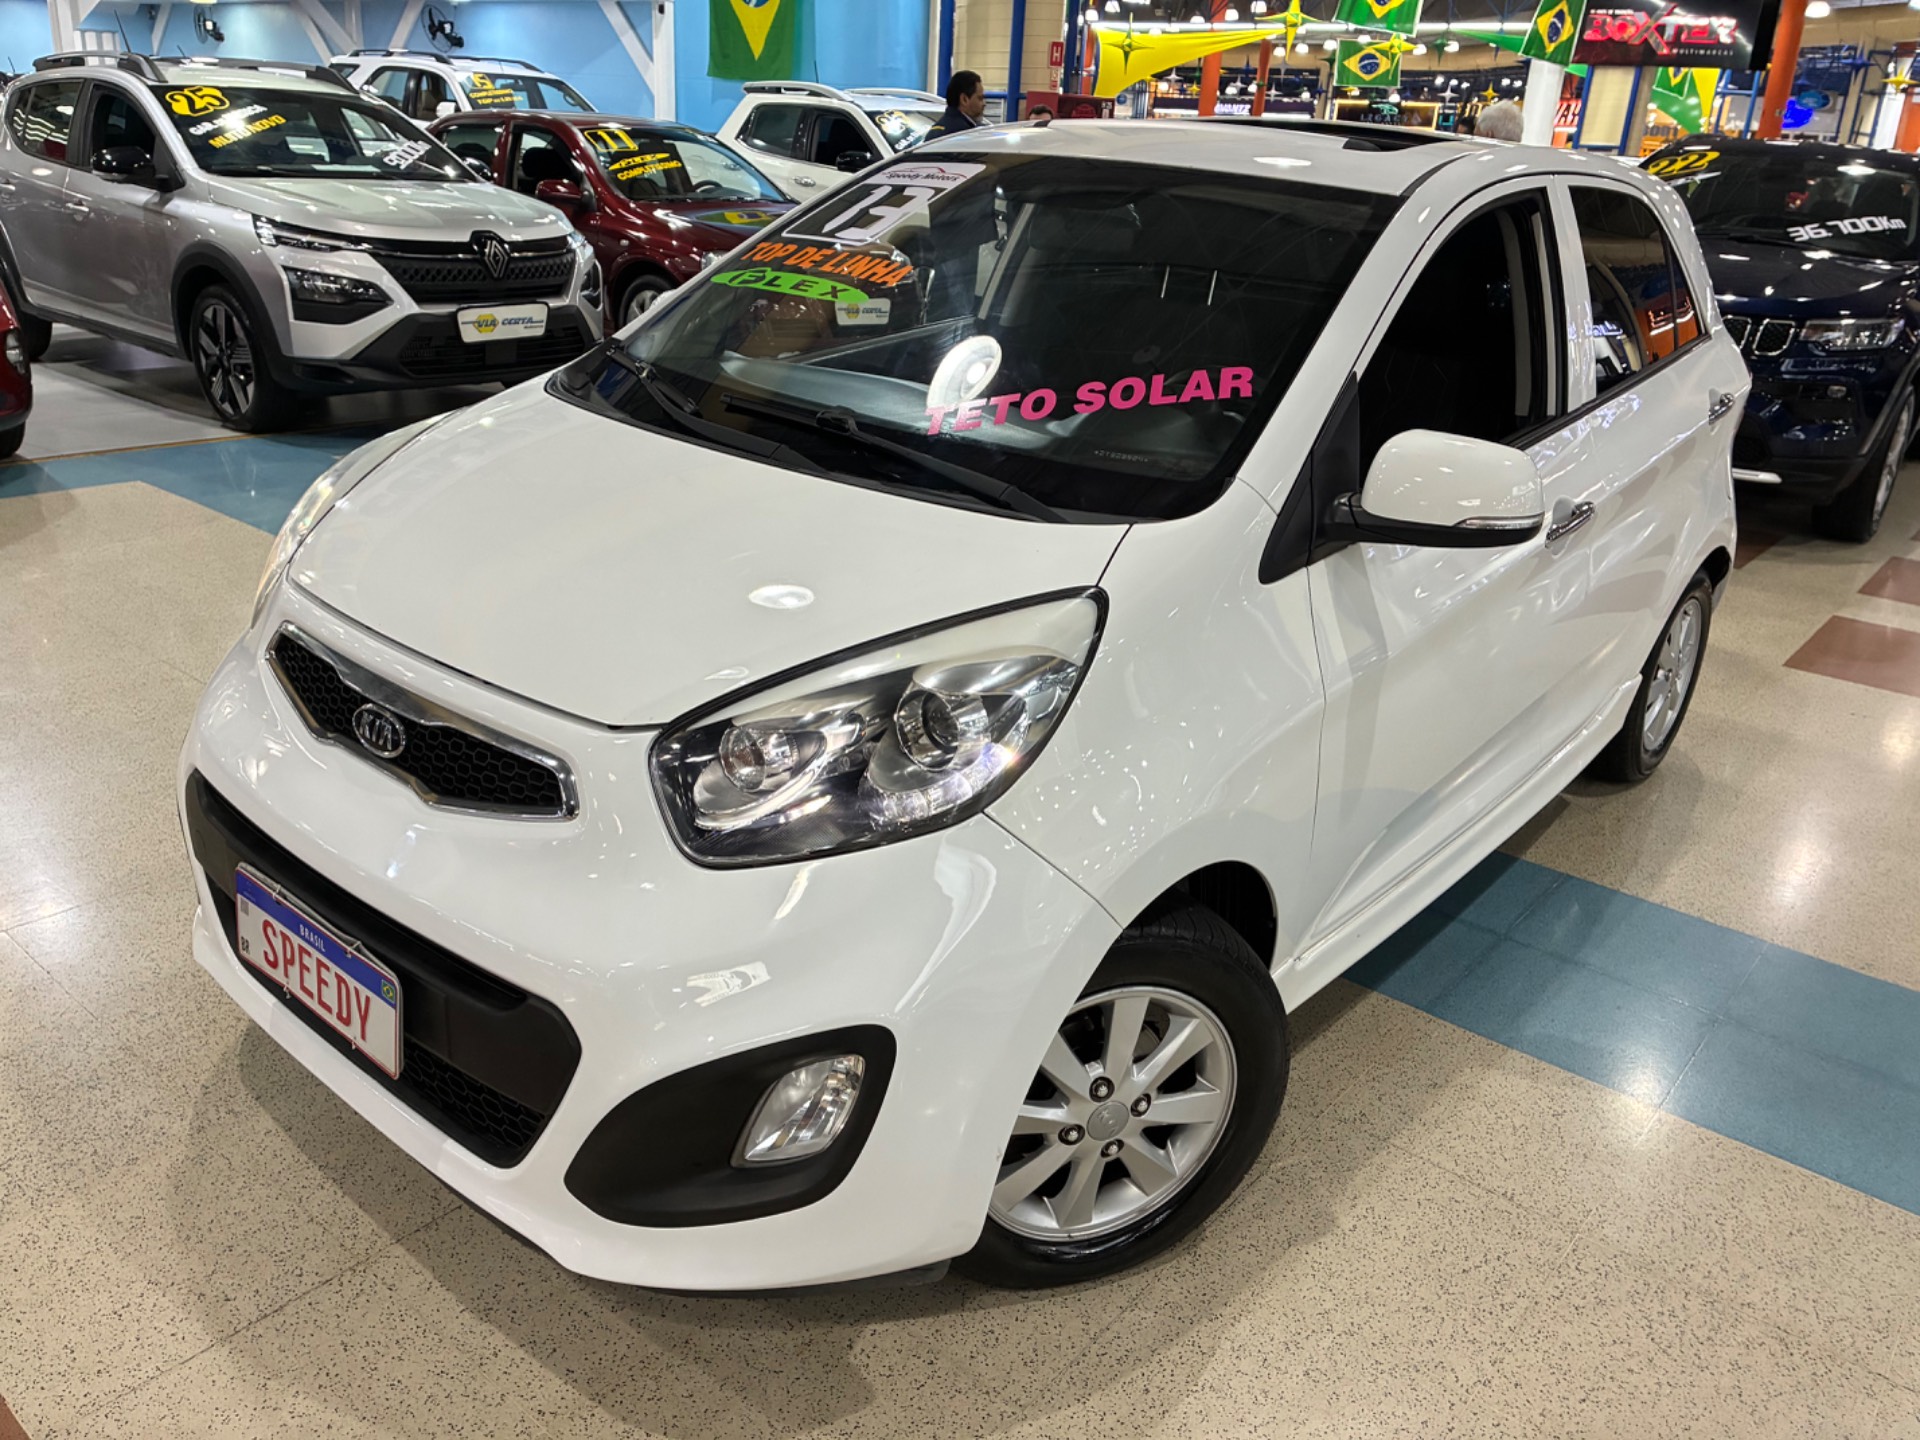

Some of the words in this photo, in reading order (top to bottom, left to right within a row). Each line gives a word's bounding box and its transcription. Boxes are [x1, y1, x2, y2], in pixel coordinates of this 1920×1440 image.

[165, 85, 230, 117] 25
[245, 114, 287, 134] NOVO
[1648, 151, 1720, 178] 22
[821, 184, 936, 241] 13
[741, 242, 798, 263] TOP
[783, 246, 837, 269] DE
[819, 252, 914, 287] LINHA
[728, 268, 850, 299] FLEX
[925, 388, 1057, 435] TETO
[1073, 366, 1255, 414] SOLAR
[300, 924, 326, 953] BRASIL
[262, 919, 370, 1042] SPEEDY
